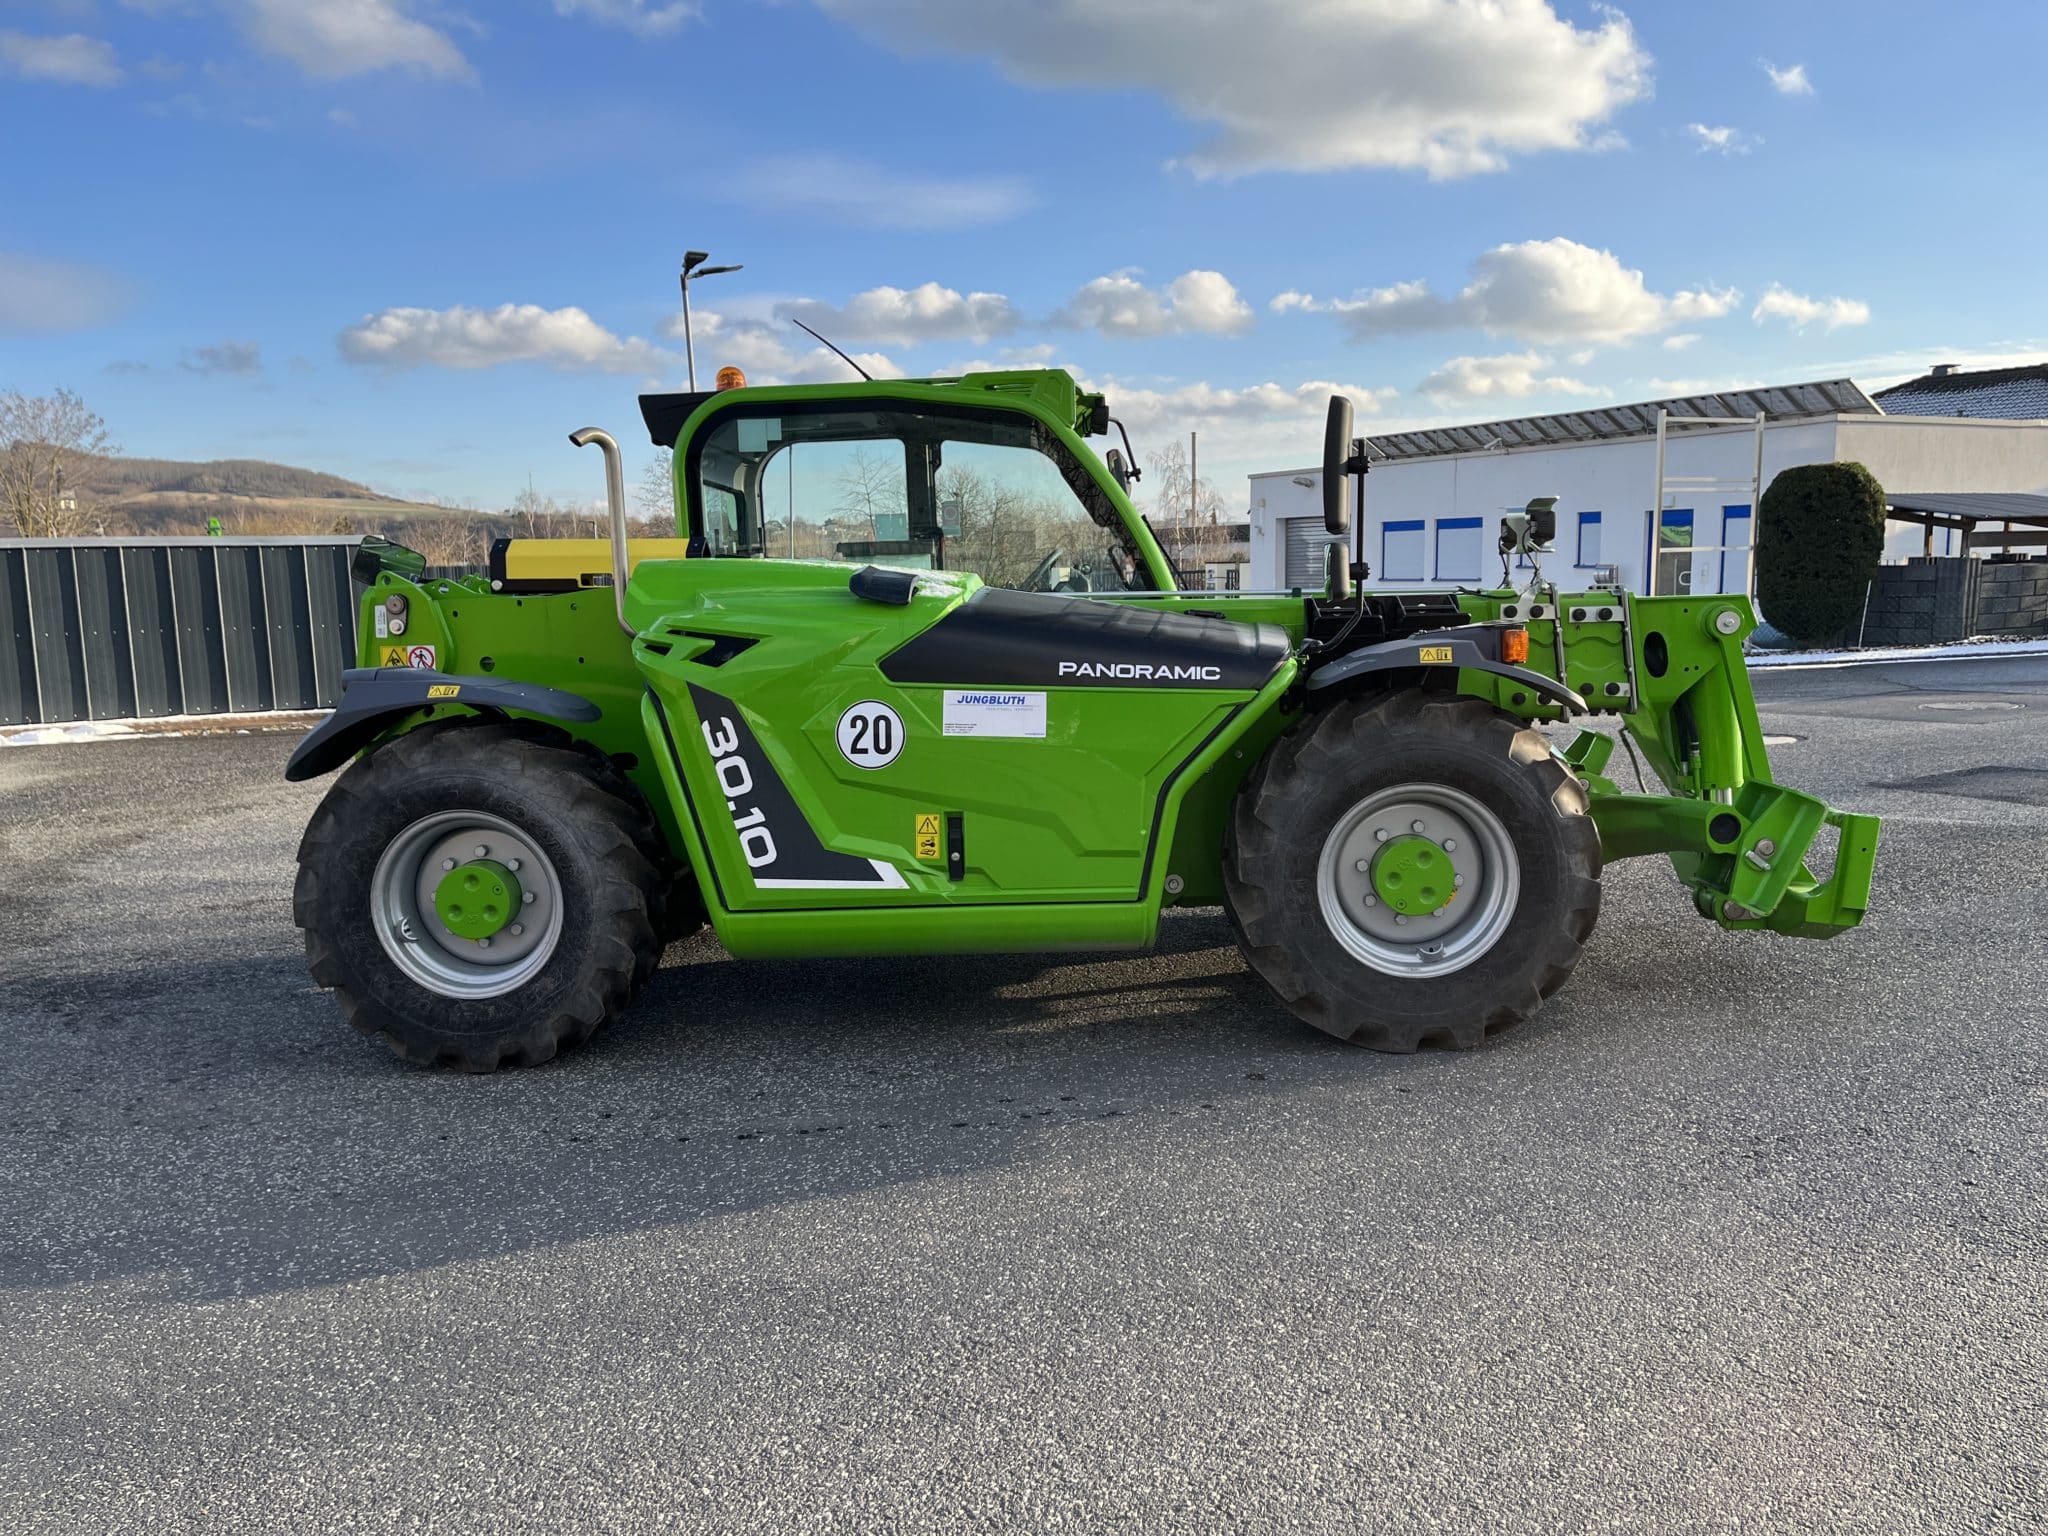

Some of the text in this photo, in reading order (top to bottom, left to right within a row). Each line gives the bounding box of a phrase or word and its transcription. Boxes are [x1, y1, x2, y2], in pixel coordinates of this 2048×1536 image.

[1058, 661, 1221, 681] PANORAMIC
[957, 694, 1026, 705] JUNGBLUTH
[850, 714, 892, 755] 20
[701, 716, 778, 868] 30.10
